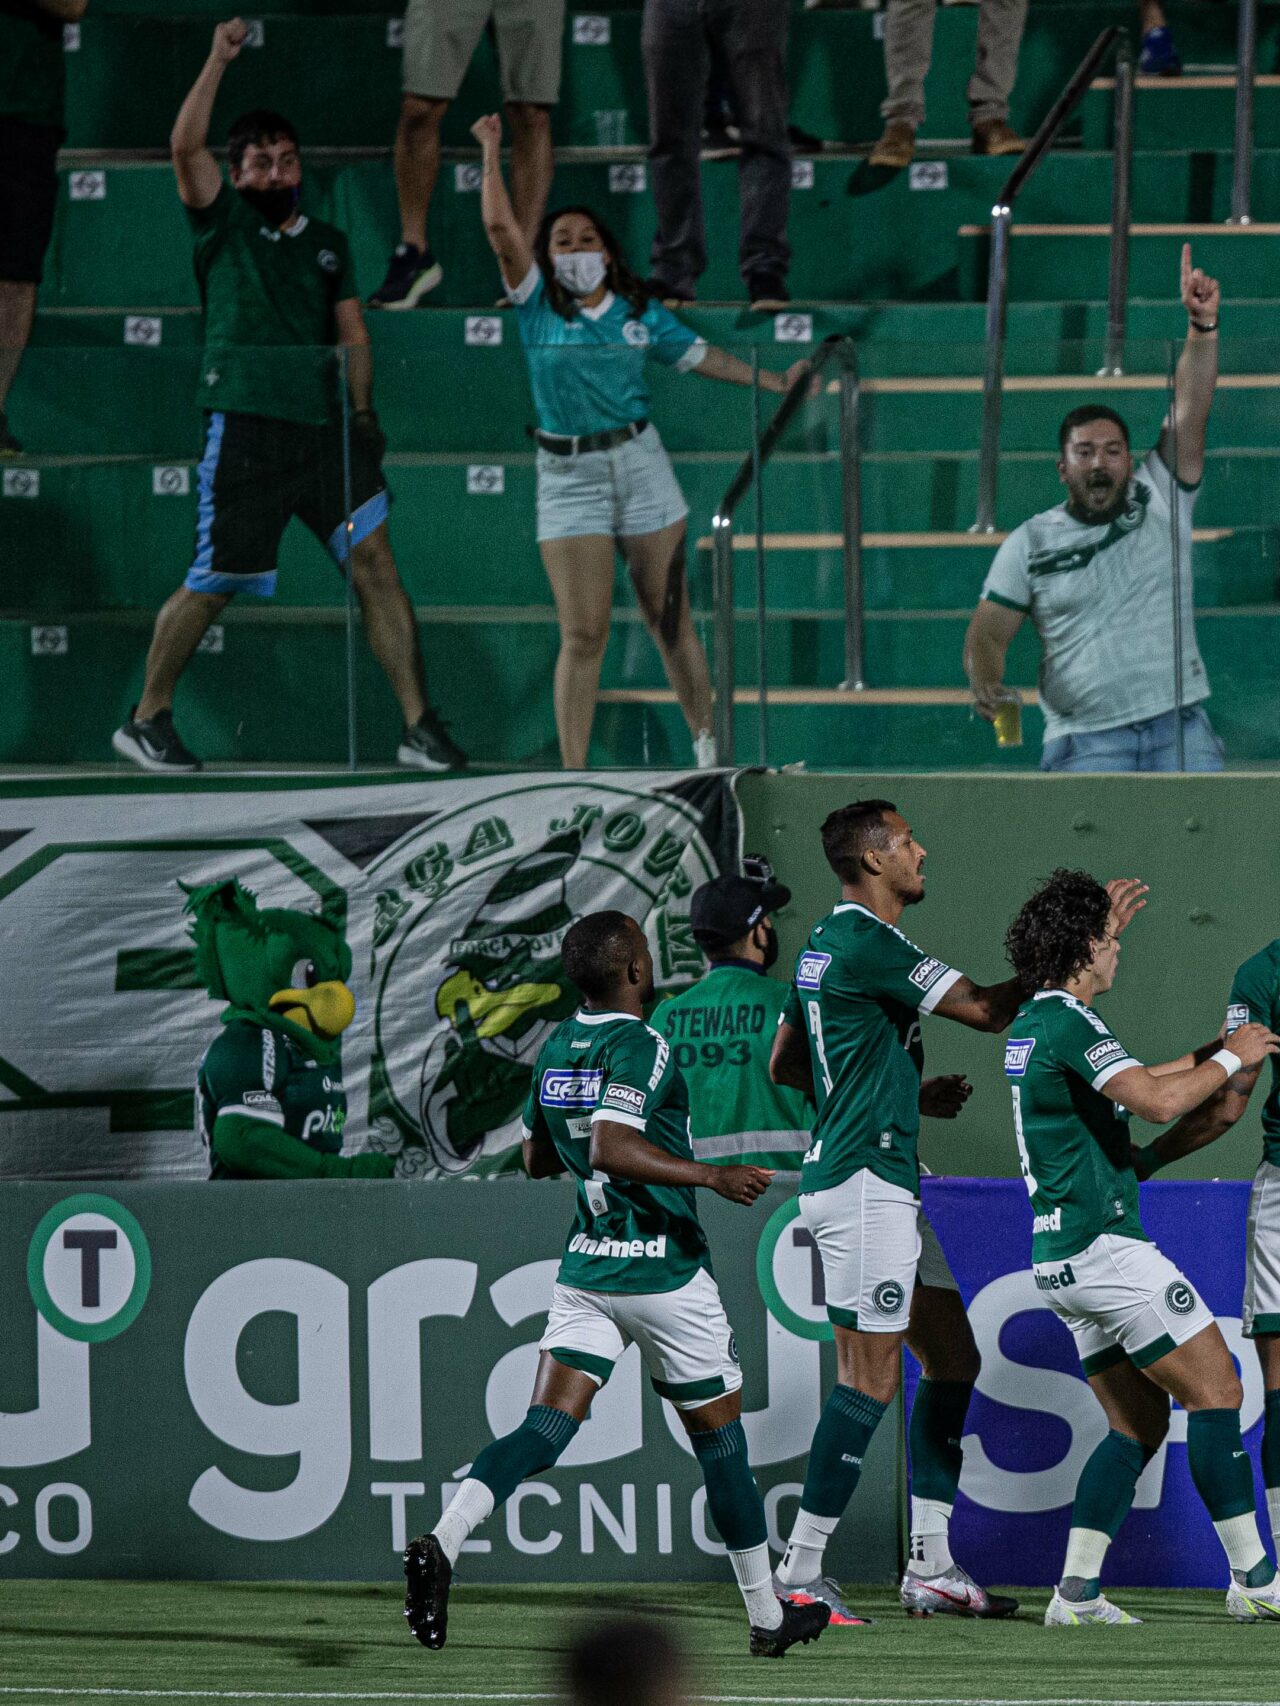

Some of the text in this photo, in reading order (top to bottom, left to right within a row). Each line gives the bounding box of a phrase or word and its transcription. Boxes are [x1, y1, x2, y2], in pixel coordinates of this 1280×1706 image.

[372, 815, 515, 948] RÇA
[664, 1003, 766, 1039] STEWARD
[672, 1039, 753, 1069] 093
[1089, 1040, 1121, 1061] GOIÁS
[607, 1086, 643, 1106] GOIÁS
[567, 1232, 667, 1259] Unimed
